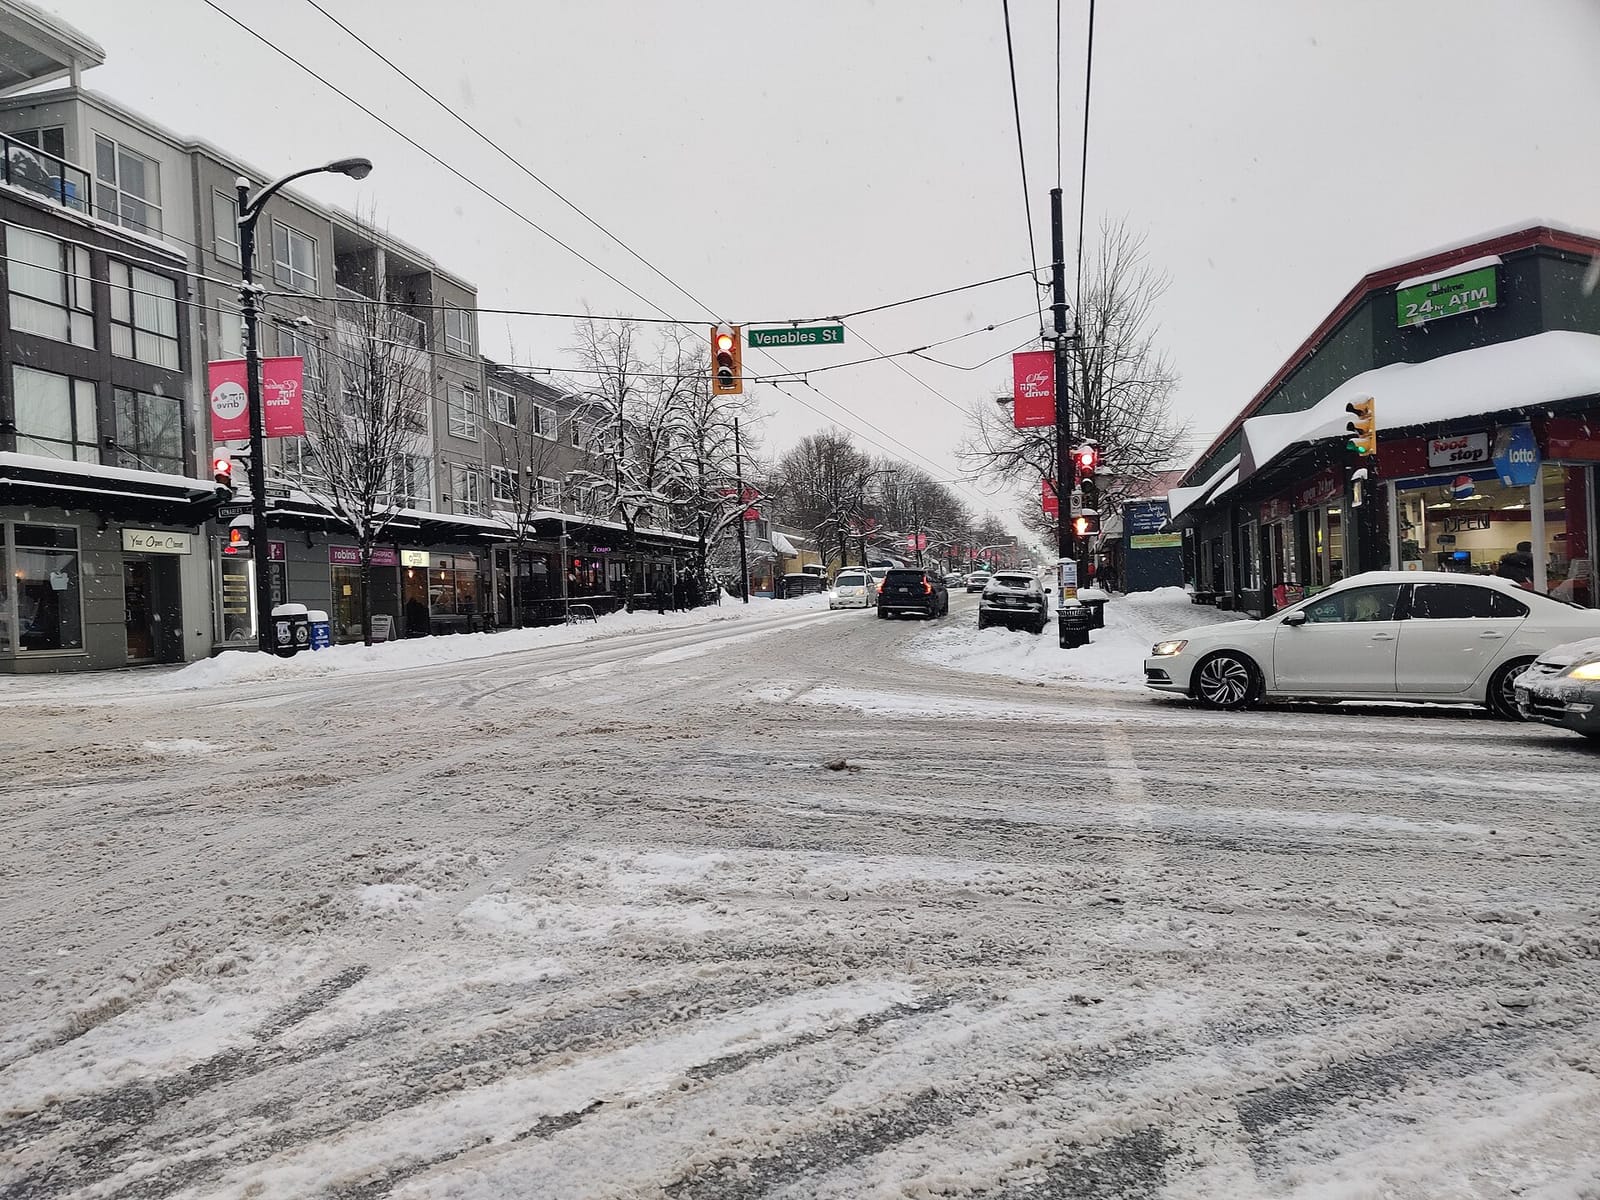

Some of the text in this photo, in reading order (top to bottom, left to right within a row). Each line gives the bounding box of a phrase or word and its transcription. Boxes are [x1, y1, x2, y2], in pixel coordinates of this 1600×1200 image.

[1448, 287, 1488, 307] ATM
[755, 329, 838, 344] Venables St
[1024, 390, 1050, 398] drive
[1433, 436, 1469, 455] food
[1449, 447, 1483, 462] stop
[1443, 513, 1491, 532] OPEN
